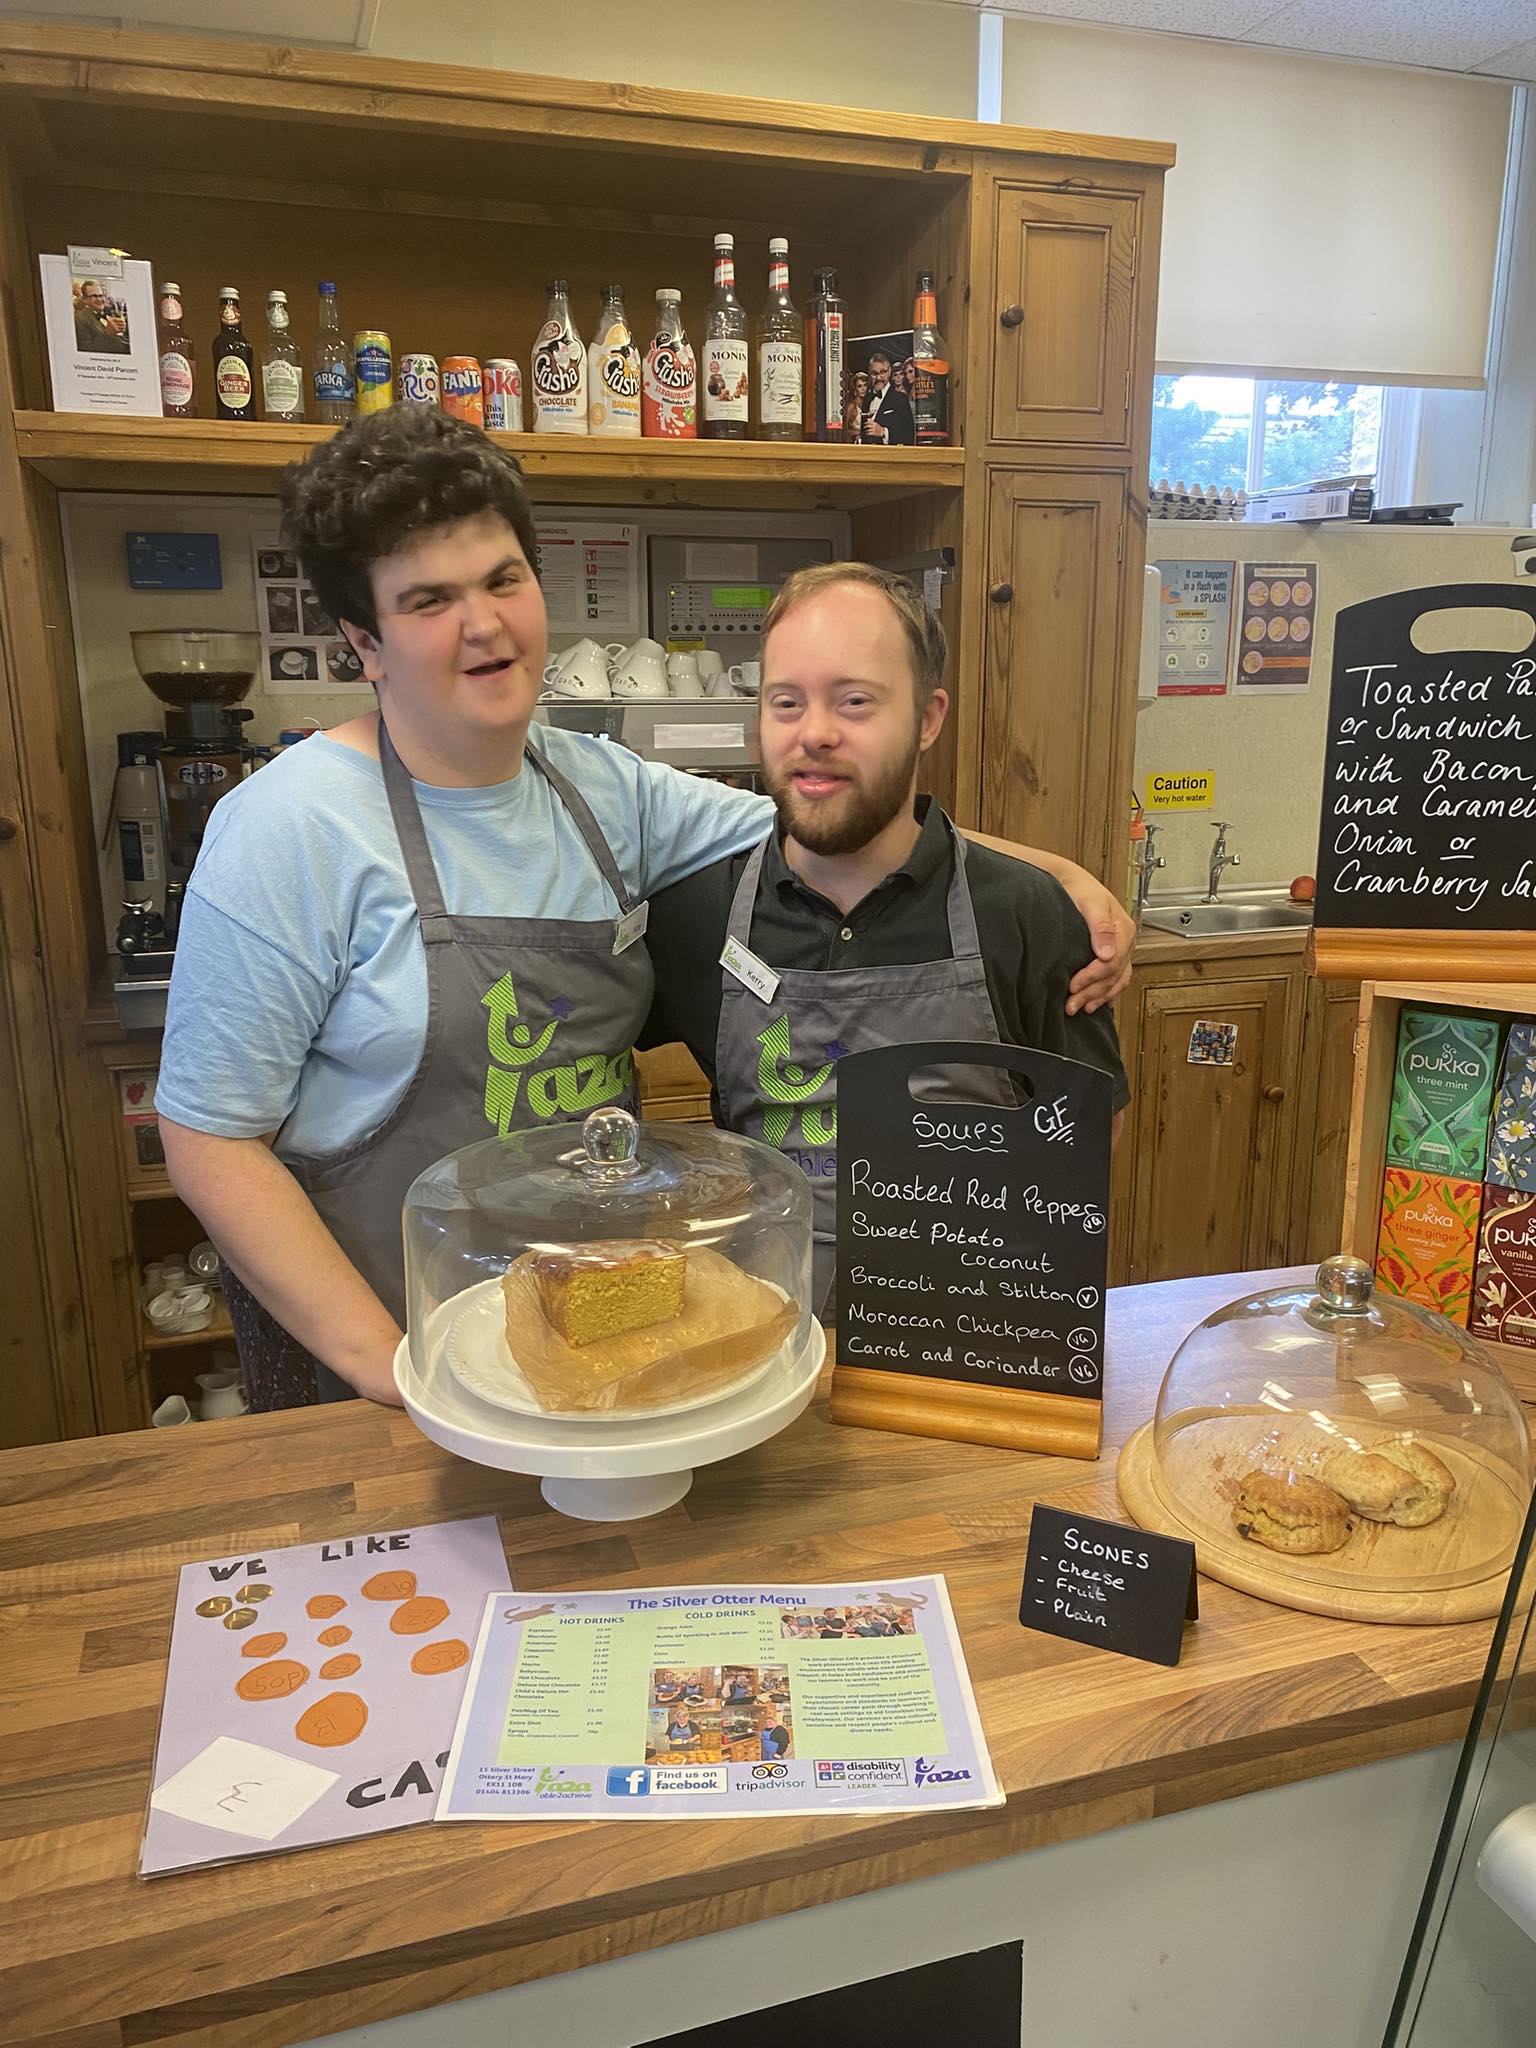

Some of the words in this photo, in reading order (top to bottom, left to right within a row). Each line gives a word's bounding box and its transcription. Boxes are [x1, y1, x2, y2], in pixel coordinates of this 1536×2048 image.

[711, 351, 747, 361] MONIN
[442, 370, 482, 390] FANT
[534, 351, 579, 393] Crusha
[651, 351, 694, 388] Crusha
[219, 379, 248, 387] GINGER
[1192, 571, 1204, 579] can
[1204, 569, 1228, 580] happen
[1200, 592, 1226, 603] SPLASH
[1345, 664, 1493, 708] Toasted
[1506, 658, 1536, 697] Pa
[1340, 716, 1368, 737] or
[1376, 706, 1533, 741] Sandwich
[1335, 752, 1402, 784] with
[1154, 776, 1208, 792] Caution
[1153, 795, 1170, 804] Very
[1172, 794, 1184, 802] hot
[1185, 794, 1206, 802] water
[1334, 794, 1400, 816] and
[1450, 836, 1477, 851] or
[1333, 858, 1490, 912] Cranberry
[746, 968, 766, 990] Kerry
[1409, 1052, 1480, 1077] pukka
[1416, 1074, 1443, 1088] three
[1445, 1080, 1468, 1091] mint
[1033, 1095, 1069, 1135] GF
[850, 1158, 956, 1205] Roasted
[966, 1178, 1008, 1212] Red
[1023, 1184, 1099, 1226] Pepper
[1404, 1208, 1454, 1228] pukka
[851, 1211, 921, 1240] Sweet
[930, 1222, 1005, 1248] Potato
[1395, 1222, 1423, 1236] three
[1425, 1228, 1460, 1243] ginger
[1494, 1226, 1536, 1247] puk
[960, 1250, 1056, 1274] coconut
[1500, 1248, 1534, 1262] vanilla
[850, 1266, 936, 1292] Broccoli
[947, 1280, 989, 1297] and
[998, 1280, 1076, 1305] Stilton
[848, 1303, 946, 1330] Moroccan
[956, 1314, 1061, 1342] Chickpea
[848, 1336, 910, 1359] Carrot
[922, 1346, 954, 1364] and
[964, 1350, 1061, 1379] Coriander
[208, 1558, 268, 1582] WE
[320, 1533, 411, 1562] LIKE
[1063, 1528, 1150, 1570] SCONES
[1057, 1559, 1126, 1591] Cheese
[1056, 1577, 1108, 1602] Fruit
[628, 1598, 659, 1611] The
[662, 1595, 713, 1609] Silver
[714, 1593, 757, 1606] Otter
[760, 1592, 806, 1606] Menu
[559, 1617, 582, 1626] HOT
[584, 1616, 626, 1625] DRINKS
[685, 1611, 713, 1620] COLD
[716, 1610, 756, 1618] DRINKS
[1053, 1598, 1108, 1628] Plain
[656, 1770, 681, 1780] Find
[686, 1772, 698, 1780] us
[702, 1771, 718, 1779] on
[846, 1760, 900, 1774] disability
[847, 1771, 904, 1782] confident
[514, 1774, 534, 1782] Mary
[656, 1779, 720, 1790] facebook
[735, 1779, 806, 1793] tripadvisor
[475, 1788, 500, 1796] 01404
